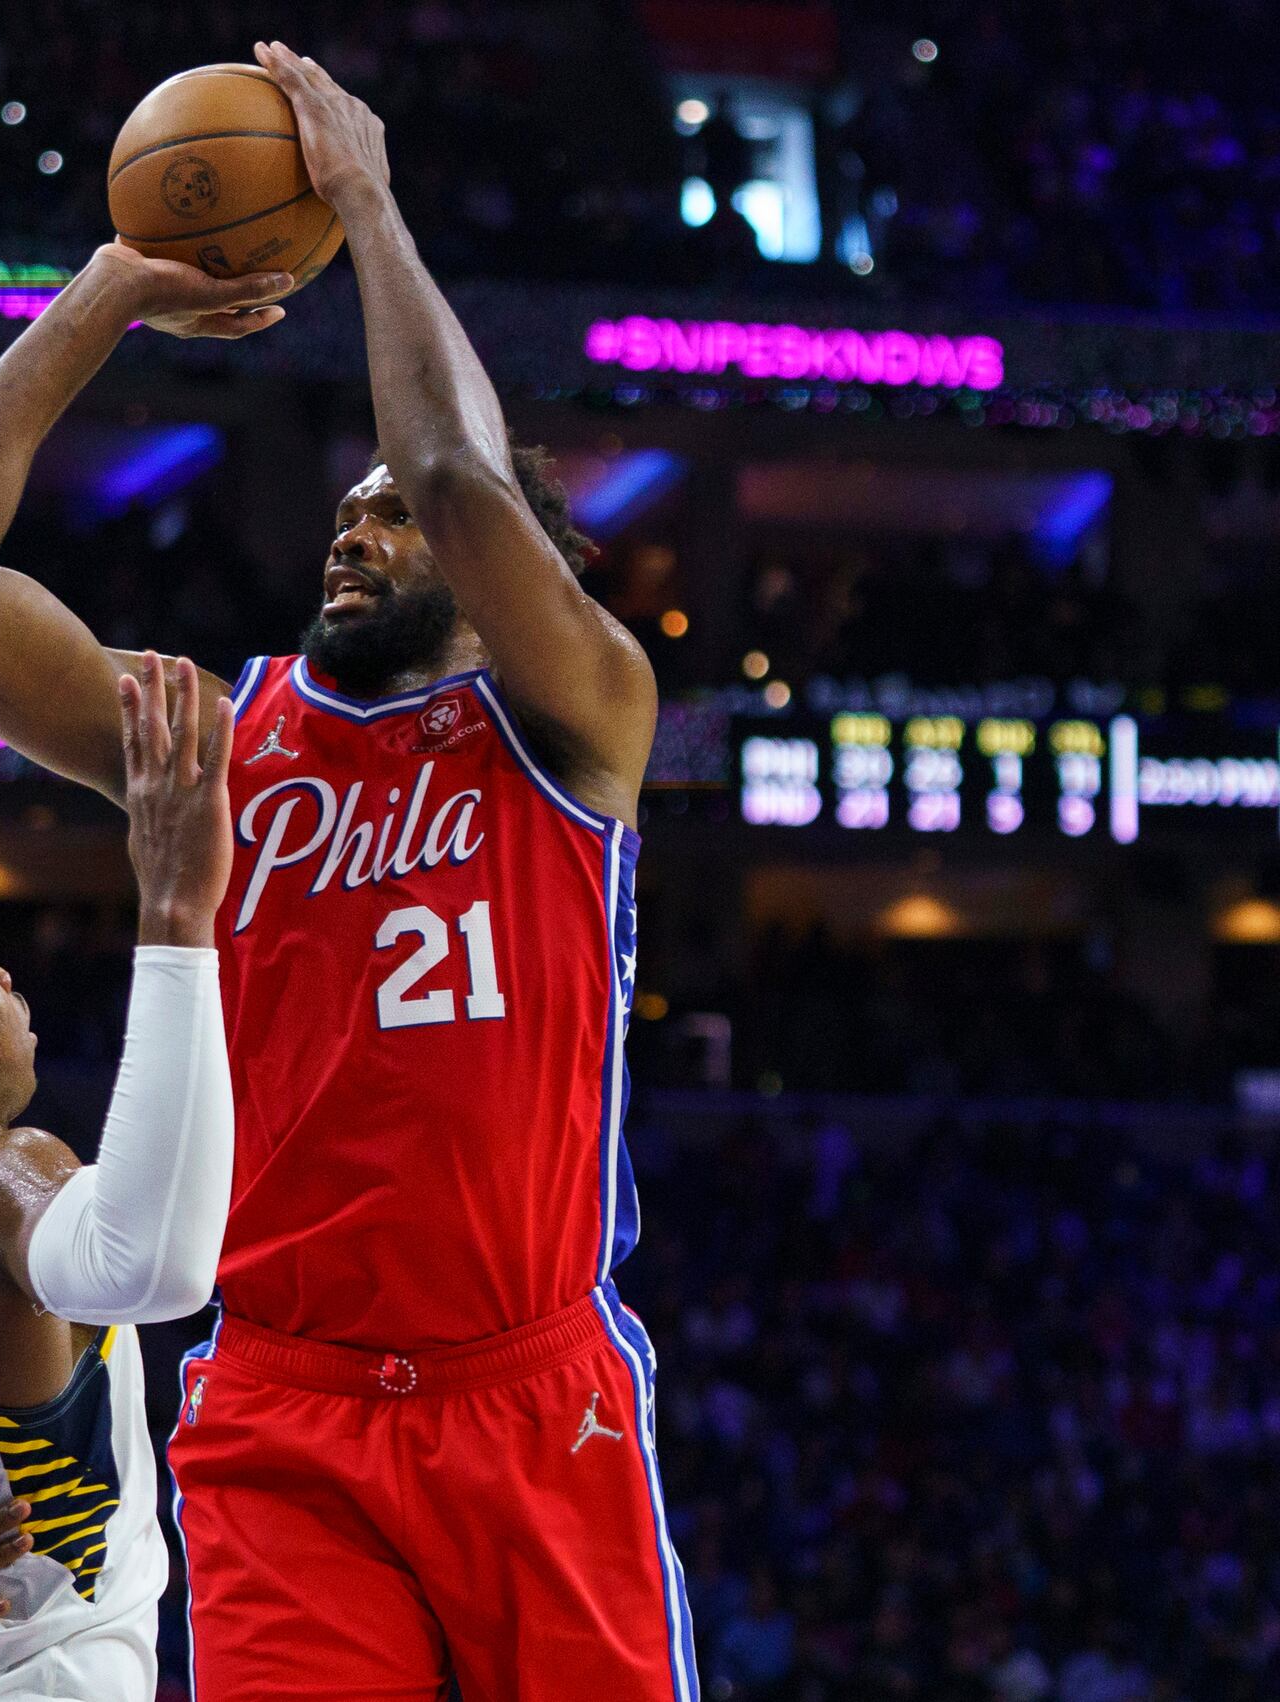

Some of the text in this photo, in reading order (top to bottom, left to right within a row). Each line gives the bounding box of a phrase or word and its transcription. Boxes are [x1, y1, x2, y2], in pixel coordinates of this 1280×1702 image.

[586, 315, 1004, 391] #SNIPESKNOWS
[233, 761, 484, 937] Phila
[375, 900, 506, 1032] 21
